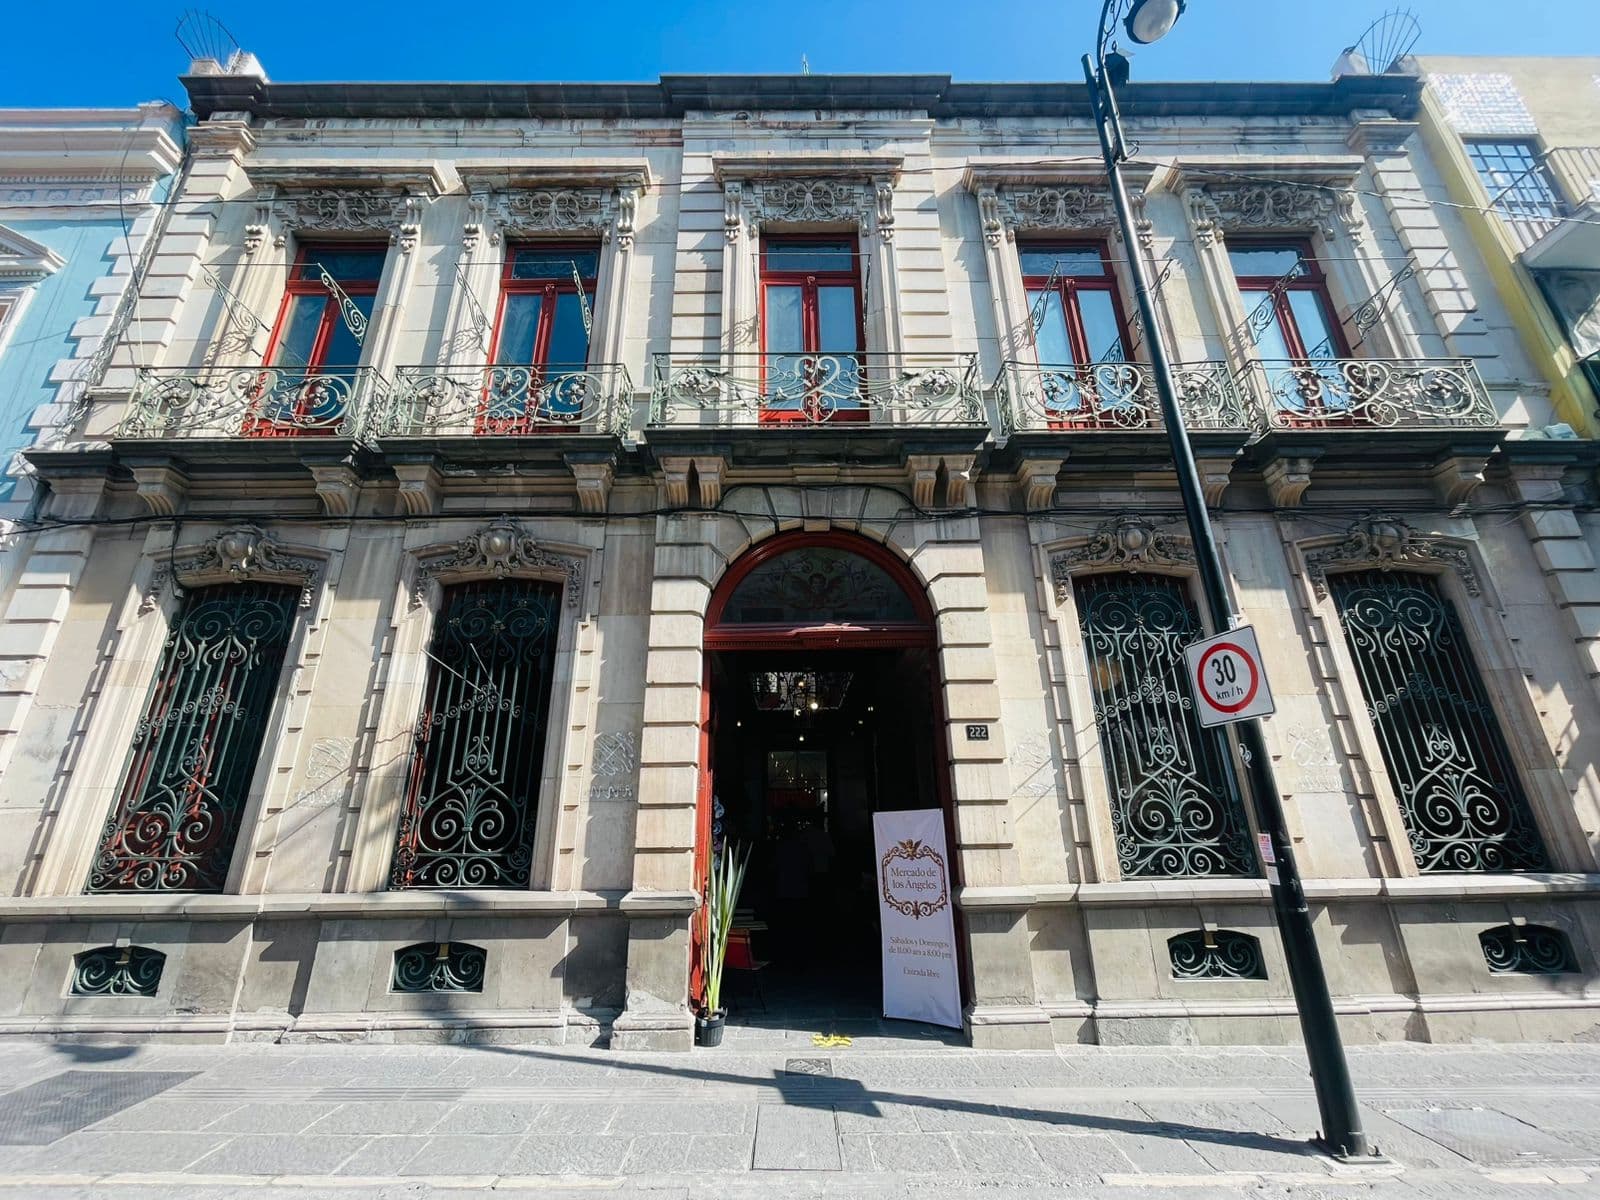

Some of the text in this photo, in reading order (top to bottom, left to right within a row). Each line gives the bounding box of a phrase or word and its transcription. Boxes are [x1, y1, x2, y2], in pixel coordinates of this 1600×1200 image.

[1212, 655, 1236, 686] 30
[969, 726, 987, 738] 222
[891, 866, 937, 877] Mercado de
[892, 879, 905, 889] los
[919, 938, 950, 949] Domingos
[888, 945, 897, 954] de
[903, 966, 940, 978] Entrada libre
